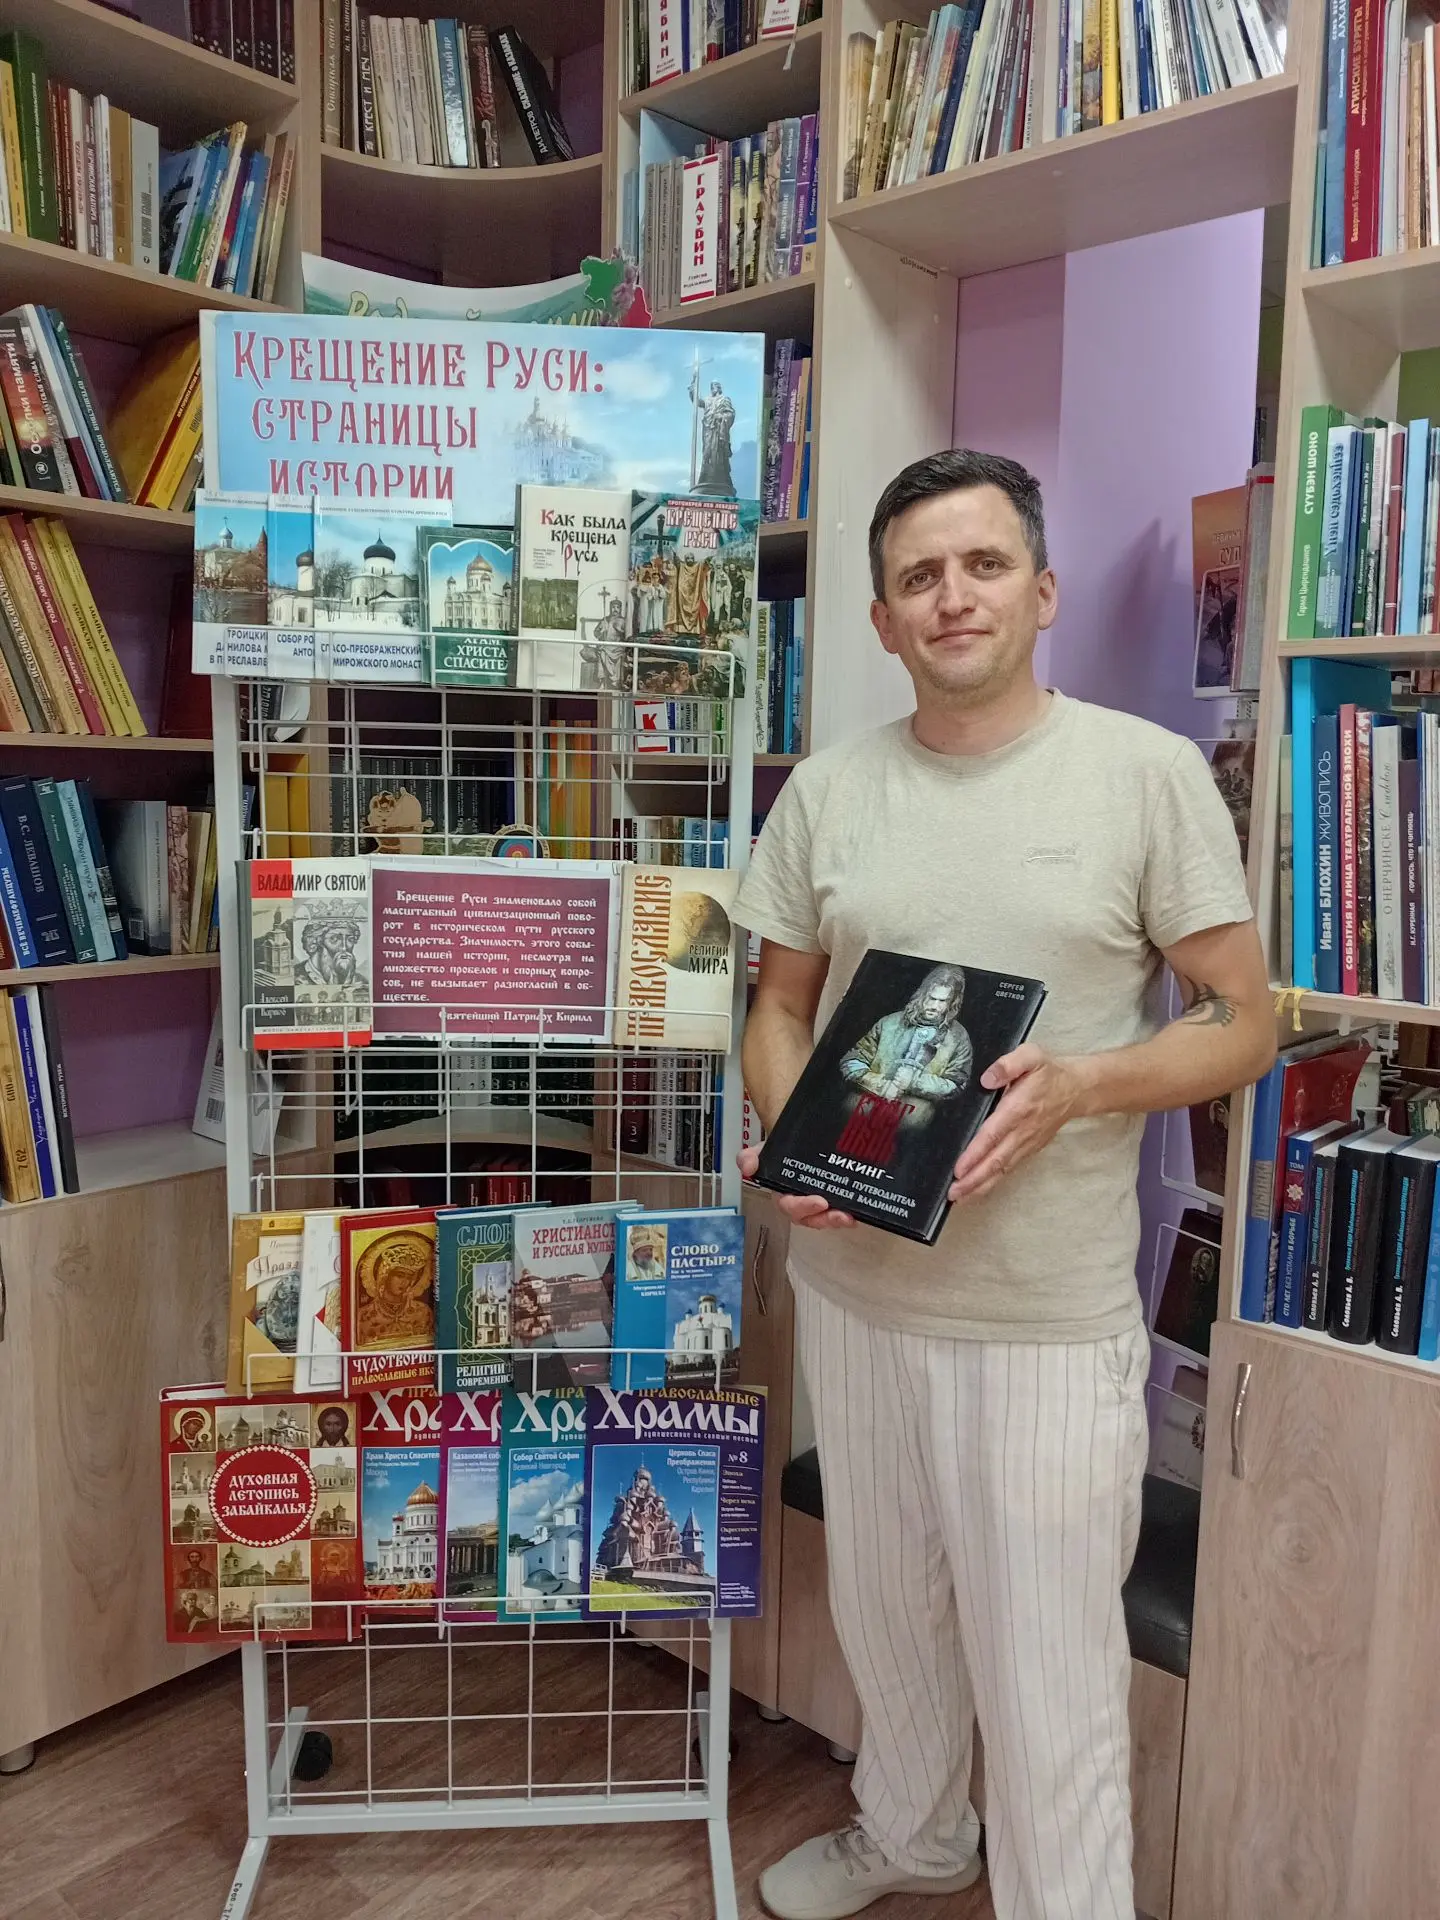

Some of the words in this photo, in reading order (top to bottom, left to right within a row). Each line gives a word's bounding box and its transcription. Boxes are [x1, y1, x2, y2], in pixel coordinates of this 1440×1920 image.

[1353, 6, 1363, 53] БУРЯТЫ
[361, 57, 371, 80] МЕЧ
[1351, 54, 1361, 115] АГИНСКИЕ
[363, 99, 374, 132] КРЕСТ
[693, 173, 705, 266] ГРАУБИН
[7, 343, 26, 393] памяти
[233, 331, 466, 392] КРЕЩЕНИЕ
[485, 342, 604, 393] РУСИ:
[78, 380, 99, 431] ПУТЕШЕСТВИЯ
[97, 434, 122, 493] ПРОДОЛЖАЮТСЯ
[252, 399, 478, 456] СТРАНИЦЫ
[1308, 431, 1319, 467] ШОНО
[270, 459, 455, 500] ИСТОРИИ
[666, 508, 737, 530] КРЕЩЕНИЕ
[277, 633, 302, 644] СОБОР
[18, 630, 40, 679] ИСТОРИЯ
[457, 645, 507, 658] ХРИСТА
[333, 657, 388, 668] МИРОЖСКОГО
[1344, 729, 1353, 771] ЭПОХИ
[1317, 750, 1332, 840] ЖИВОПИСЬ
[1344, 774, 1353, 861] ТЕАТРАЛЬНОЙ
[17, 815, 27, 837] В.С.
[24, 839, 45, 894] ЛЕВАШОВ
[1382, 825, 1393, 902] НЕРЧИНСКЕ
[257, 875, 321, 891] ВЛАДИМИР
[325, 873, 366, 891] СВЯТОЙ
[1318, 845, 1332, 908] БЛОХИН
[1344, 863, 1353, 898] ЛИЦА
[396, 890, 454, 904] Крещение
[461, 893, 488, 906] Руси
[493, 896, 562, 906] знаменовало
[567, 898, 597, 907] собой
[1344, 899, 1353, 909] И
[382, 907, 457, 917] масштабный
[463, 909, 561, 921] цивилизационный
[1383, 905, 1392, 915] О
[382, 921, 404, 931] рот
[413, 922, 421, 931] в
[430, 923, 506, 934] историческом
[515, 925, 542, 935] пути
[551, 927, 596, 937] русского
[1319, 912, 1332, 950] Иван
[382, 936, 454, 947] государства.
[460, 935, 526, 946] Значимость
[531, 940, 561, 948] этого
[565, 941, 596, 949] собы-
[1345, 911, 1353, 970] СОБЫТИЯ
[382, 950, 405, 958] тия
[416, 950, 453, 959] нашей
[463, 952, 510, 962] истории,
[520, 953, 571, 964] несмотря
[581, 955, 595, 963] на
[627, 874, 672, 1038] ПРАВОСЛАВИЕ
[688, 944, 729, 957] РЕЛИГИИ
[382, 965, 445, 973] множество
[449, 966, 498, 976] пробелов
[513, 967, 556, 978] спорных
[560, 968, 594, 978] вопро-
[688, 956, 729, 975] МИРА
[382, 979, 405, 988] сов,
[410, 979, 425, 987] не
[430, 980, 488, 988] вызывает
[494, 981, 558, 990] разногласий
[576, 982, 594, 990] об-
[998, 980, 1025, 992] СЕРГЕЙ
[382, 993, 430, 1002] ществе.
[995, 989, 1025, 1001] ЦВЕТКОВ
[556, 1011, 593, 1022] Кирилл
[827, 1153, 886, 1180] ВИКИНГ
[782, 1156, 849, 1187] ИСТОРИЧЕСКИЙ
[851, 1179, 917, 1209] ПУТЕВОДИТЕЛЬ
[781, 1168, 795, 1180] ПО
[797, 1173, 826, 1191] ЭПОХЕ
[826, 1184, 855, 1200] КНЯЗЯ
[857, 1192, 909, 1219] ВЛАДИМИРА
[532, 1247, 540, 1259] И
[543, 1243, 584, 1258] РУССКАЯ
[671, 1244, 719, 1256] СЛОВО
[671, 1255, 736, 1268] ПАСТЫРЯ
[1284, 1290, 1292, 1303] ЛЕТ
[1288, 1217, 1297, 1244] БОРЬБЕ
[1341, 1293, 1352, 1328] Соловьев
[1390, 1302, 1401, 1338] Соловьев
[352, 1368, 417, 1385] ПРАВОСЛАВНЫЕ
[638, 1388, 760, 1407] ПРАВОСЛАВНЫЕ
[594, 1385, 760, 1440] Храмы
[366, 1452, 384, 1460] Храм
[385, 1452, 408, 1460] Христа
[452, 1452, 488, 1460] Казанский
[513, 1453, 533, 1462] Собор
[534, 1452, 558, 1460] Святой
[558, 1451, 580, 1461] Софии
[667, 1458, 716, 1467] Преображения
[668, 1449, 697, 1458] Церковь
[697, 1449, 716, 1457] Спаса
[739, 1450, 748, 1464] 8
[229, 1473, 298, 1490] ДУХОВНАЯ
[228, 1488, 300, 1502] ЛЕТОПИСЬ
[221, 1502, 307, 1518] ЗАБАЙКАЛЬЯ
